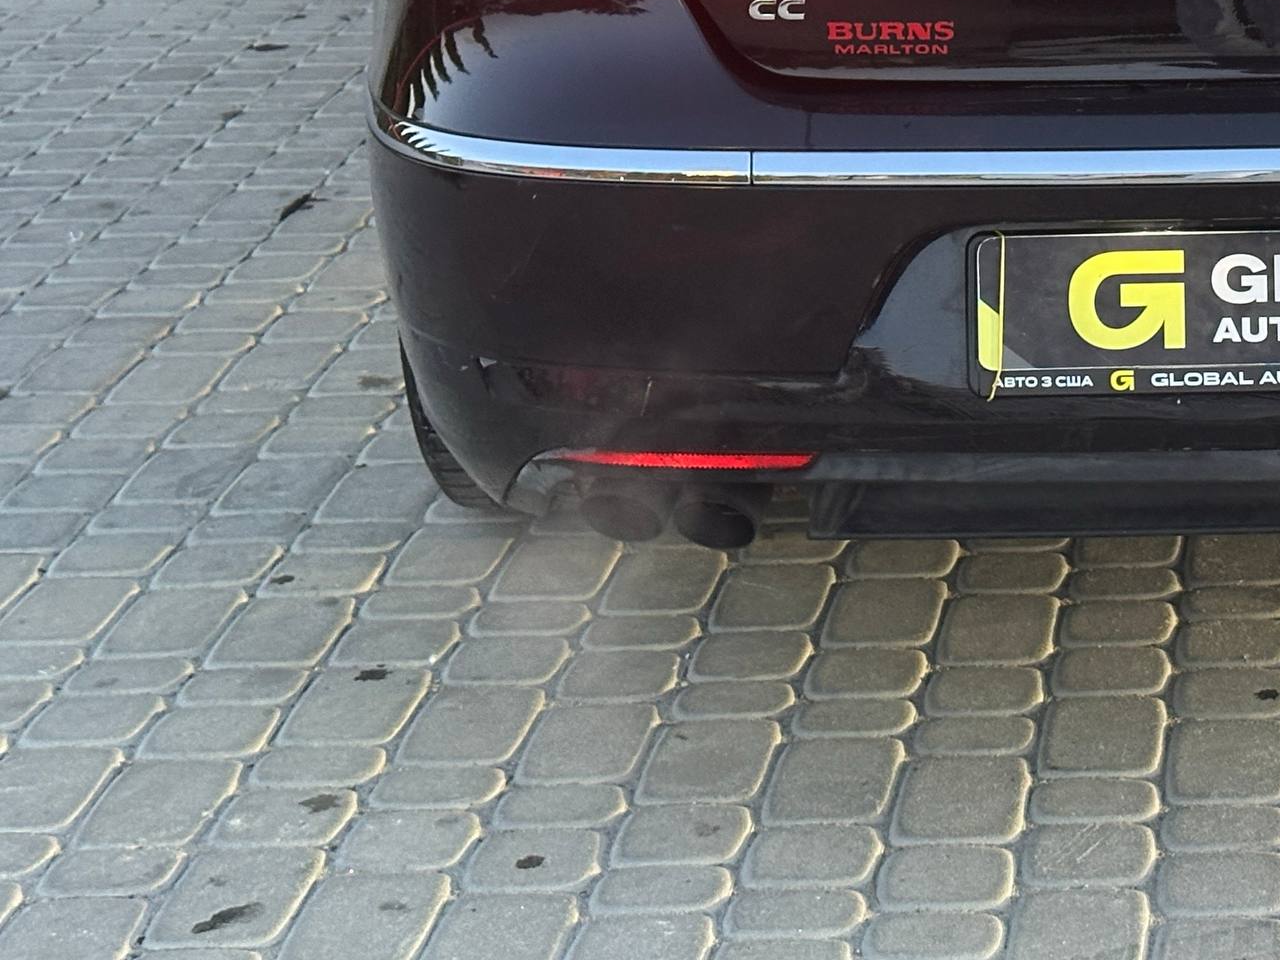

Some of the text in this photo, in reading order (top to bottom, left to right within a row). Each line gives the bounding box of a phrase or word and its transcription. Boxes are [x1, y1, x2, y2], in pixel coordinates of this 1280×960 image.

[826, 21, 955, 41] BURNS
[834, 43, 949, 55] MARLTON
[993, 375, 1039, 388] АВТО
[1056, 375, 1094, 388] США
[1150, 371, 1254, 388] GLOBAL
